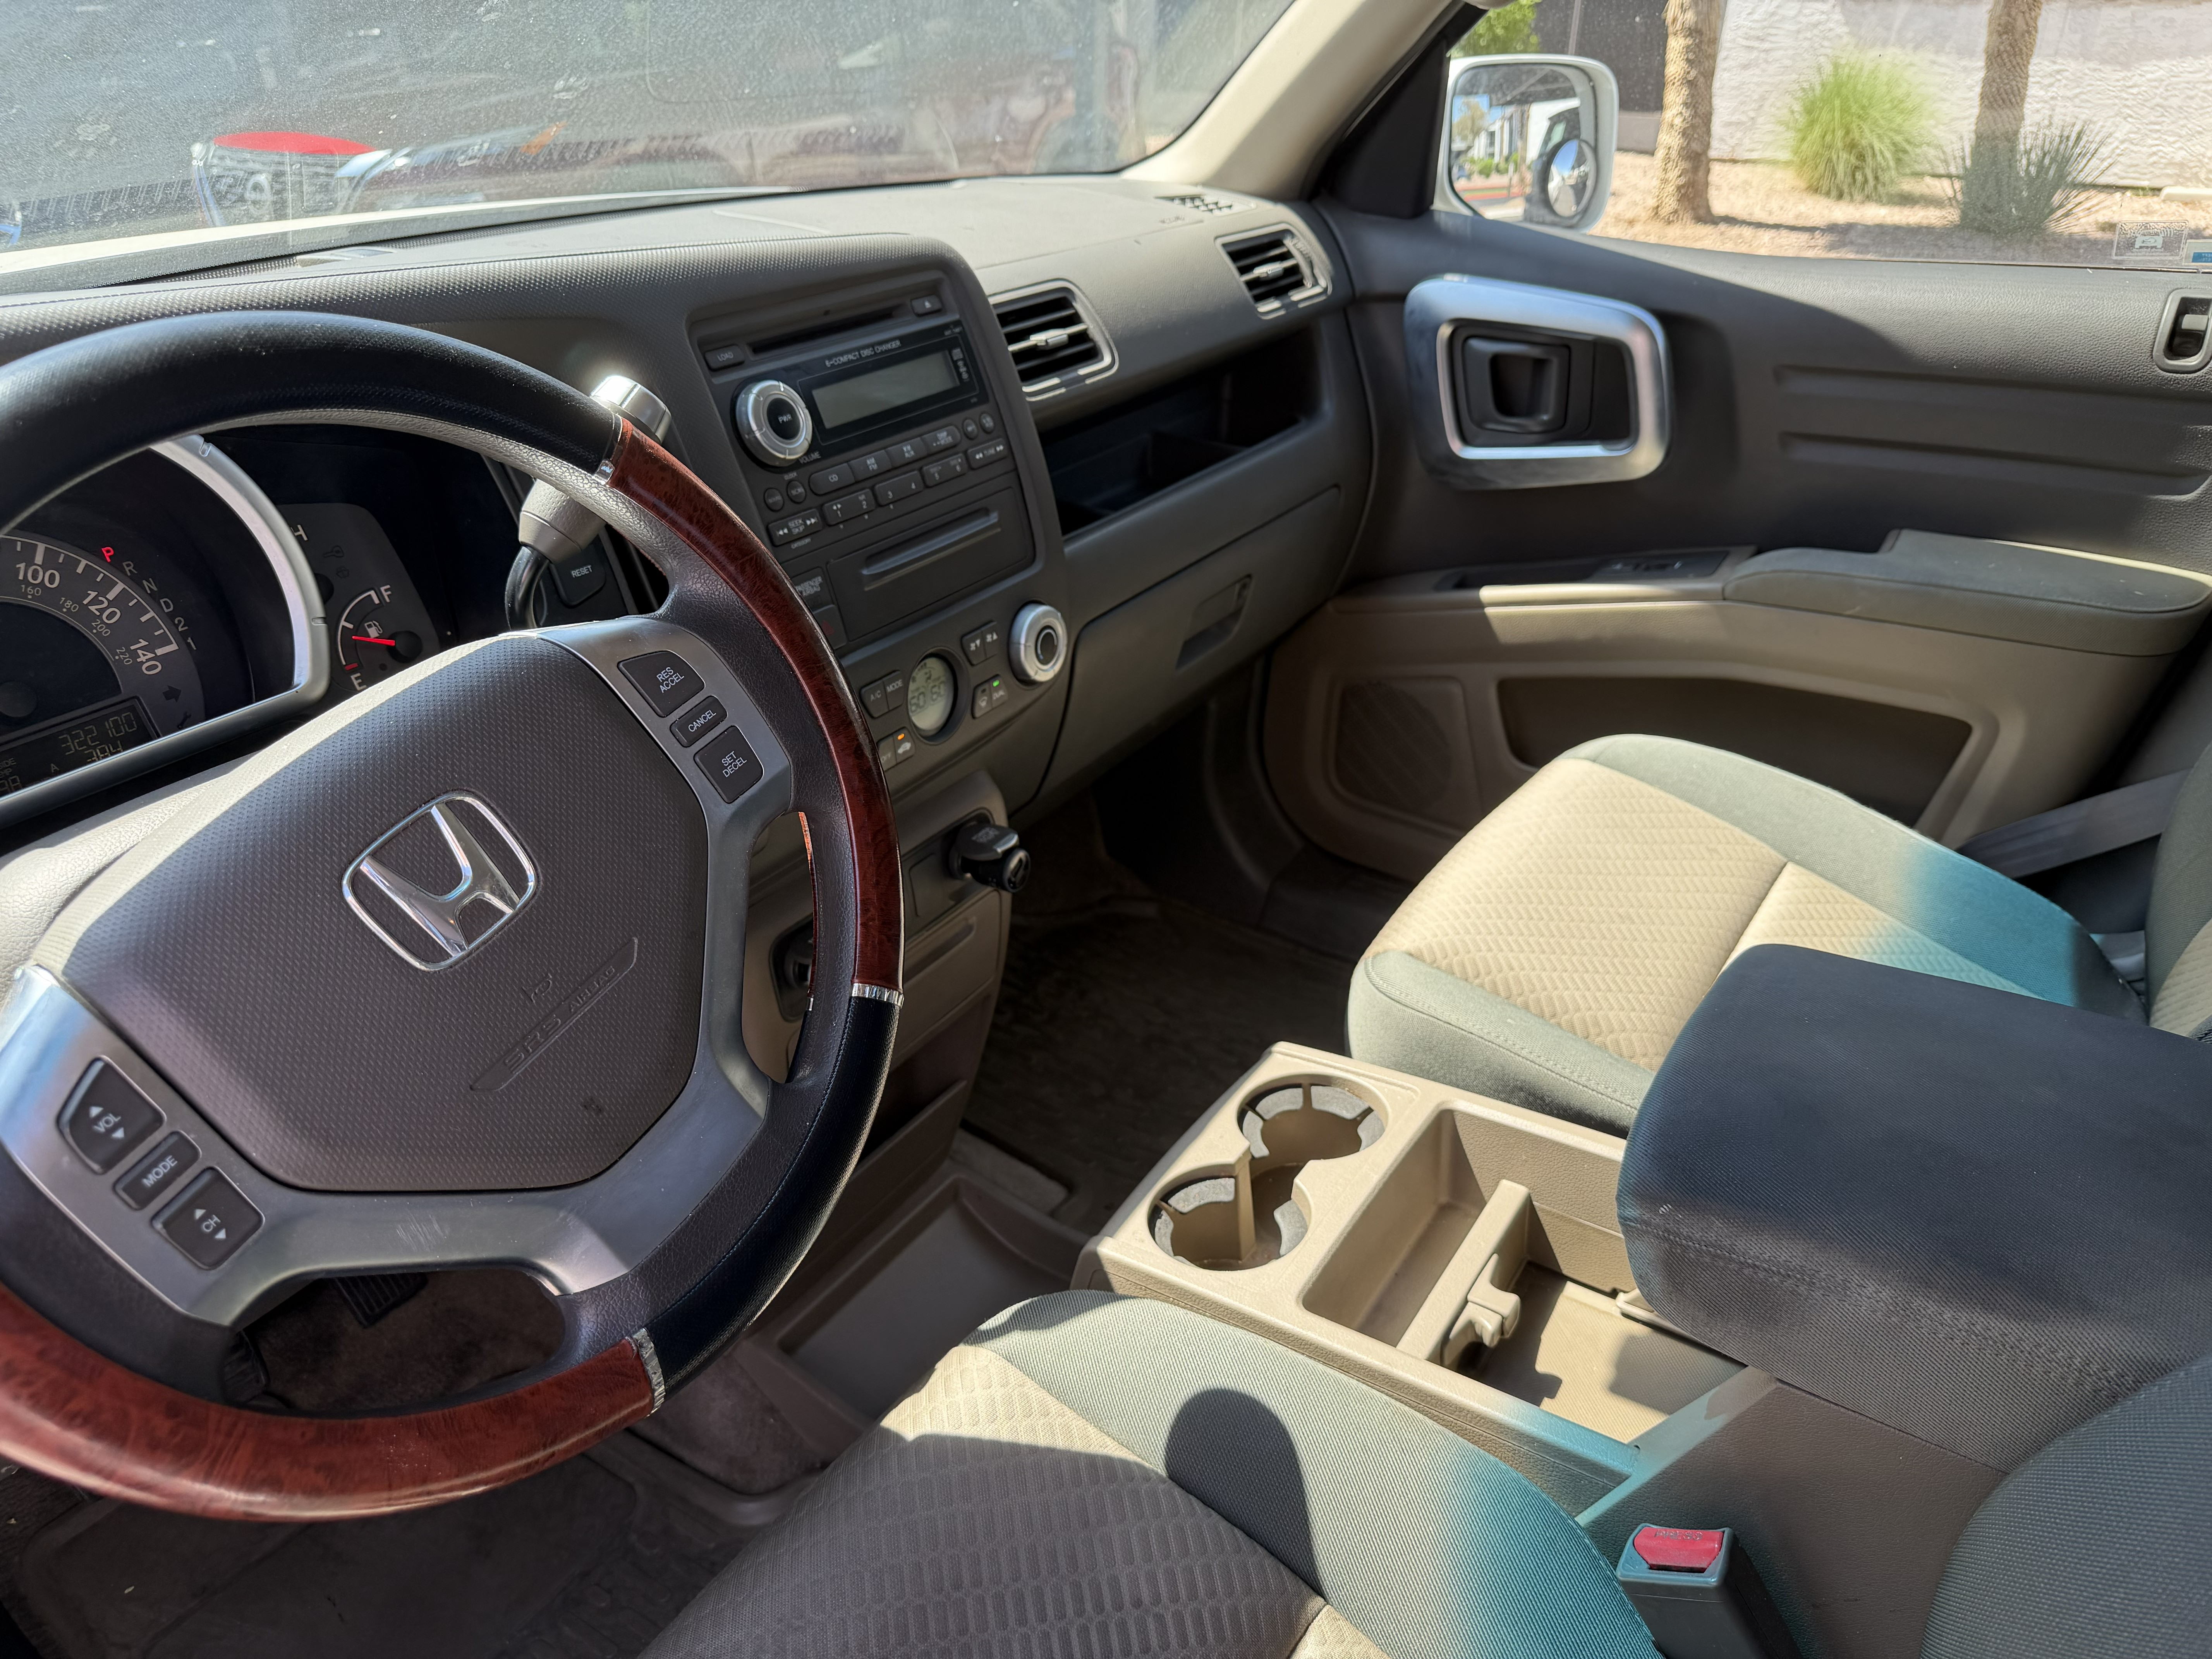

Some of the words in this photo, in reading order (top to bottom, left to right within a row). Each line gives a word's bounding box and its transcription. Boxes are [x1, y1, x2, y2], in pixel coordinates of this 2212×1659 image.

[716, 352, 734, 362] LOAD
[860, 347, 874, 357] DISC
[777, 414, 793, 424] PWR
[799, 452, 821, 464] VOLUME
[862, 500, 867, 509] 2
[788, 519, 804, 528] SEEK
[16, 562, 60, 588] 100
[571, 565, 592, 578] RESET
[21, 585, 41, 596] 160
[101, 547, 114, 562] P
[122, 561, 137, 576] R
[142, 578, 158, 593] N
[160, 598, 173, 612] D
[175, 617, 188, 632] 2
[187, 637, 196, 650] 1
[380, 585, 392, 603] F
[60, 597, 79, 612] 180
[82, 591, 121, 623] 120
[91, 619, 111, 636] 200
[116, 647, 132, 665] 220
[130, 639, 162, 675] 140
[351, 673, 367, 691] E
[656, 667, 674, 682] RES
[659, 672, 685, 693] ACCEL
[886, 679, 903, 692] MODE
[871, 690, 881, 701] A/C
[688, 710, 717, 732] CANCEL
[58, 712, 137, 755] 322100
[721, 751, 737, 766] SET
[51, 763, 60, 773] A
[722, 757, 747, 778] DECEL
[93, 1112, 121, 1133] VOL
[142, 1155, 178, 1188] MODE
[202, 1214, 222, 1232] CH
[1654, 1530, 1703, 1540] PRESS
